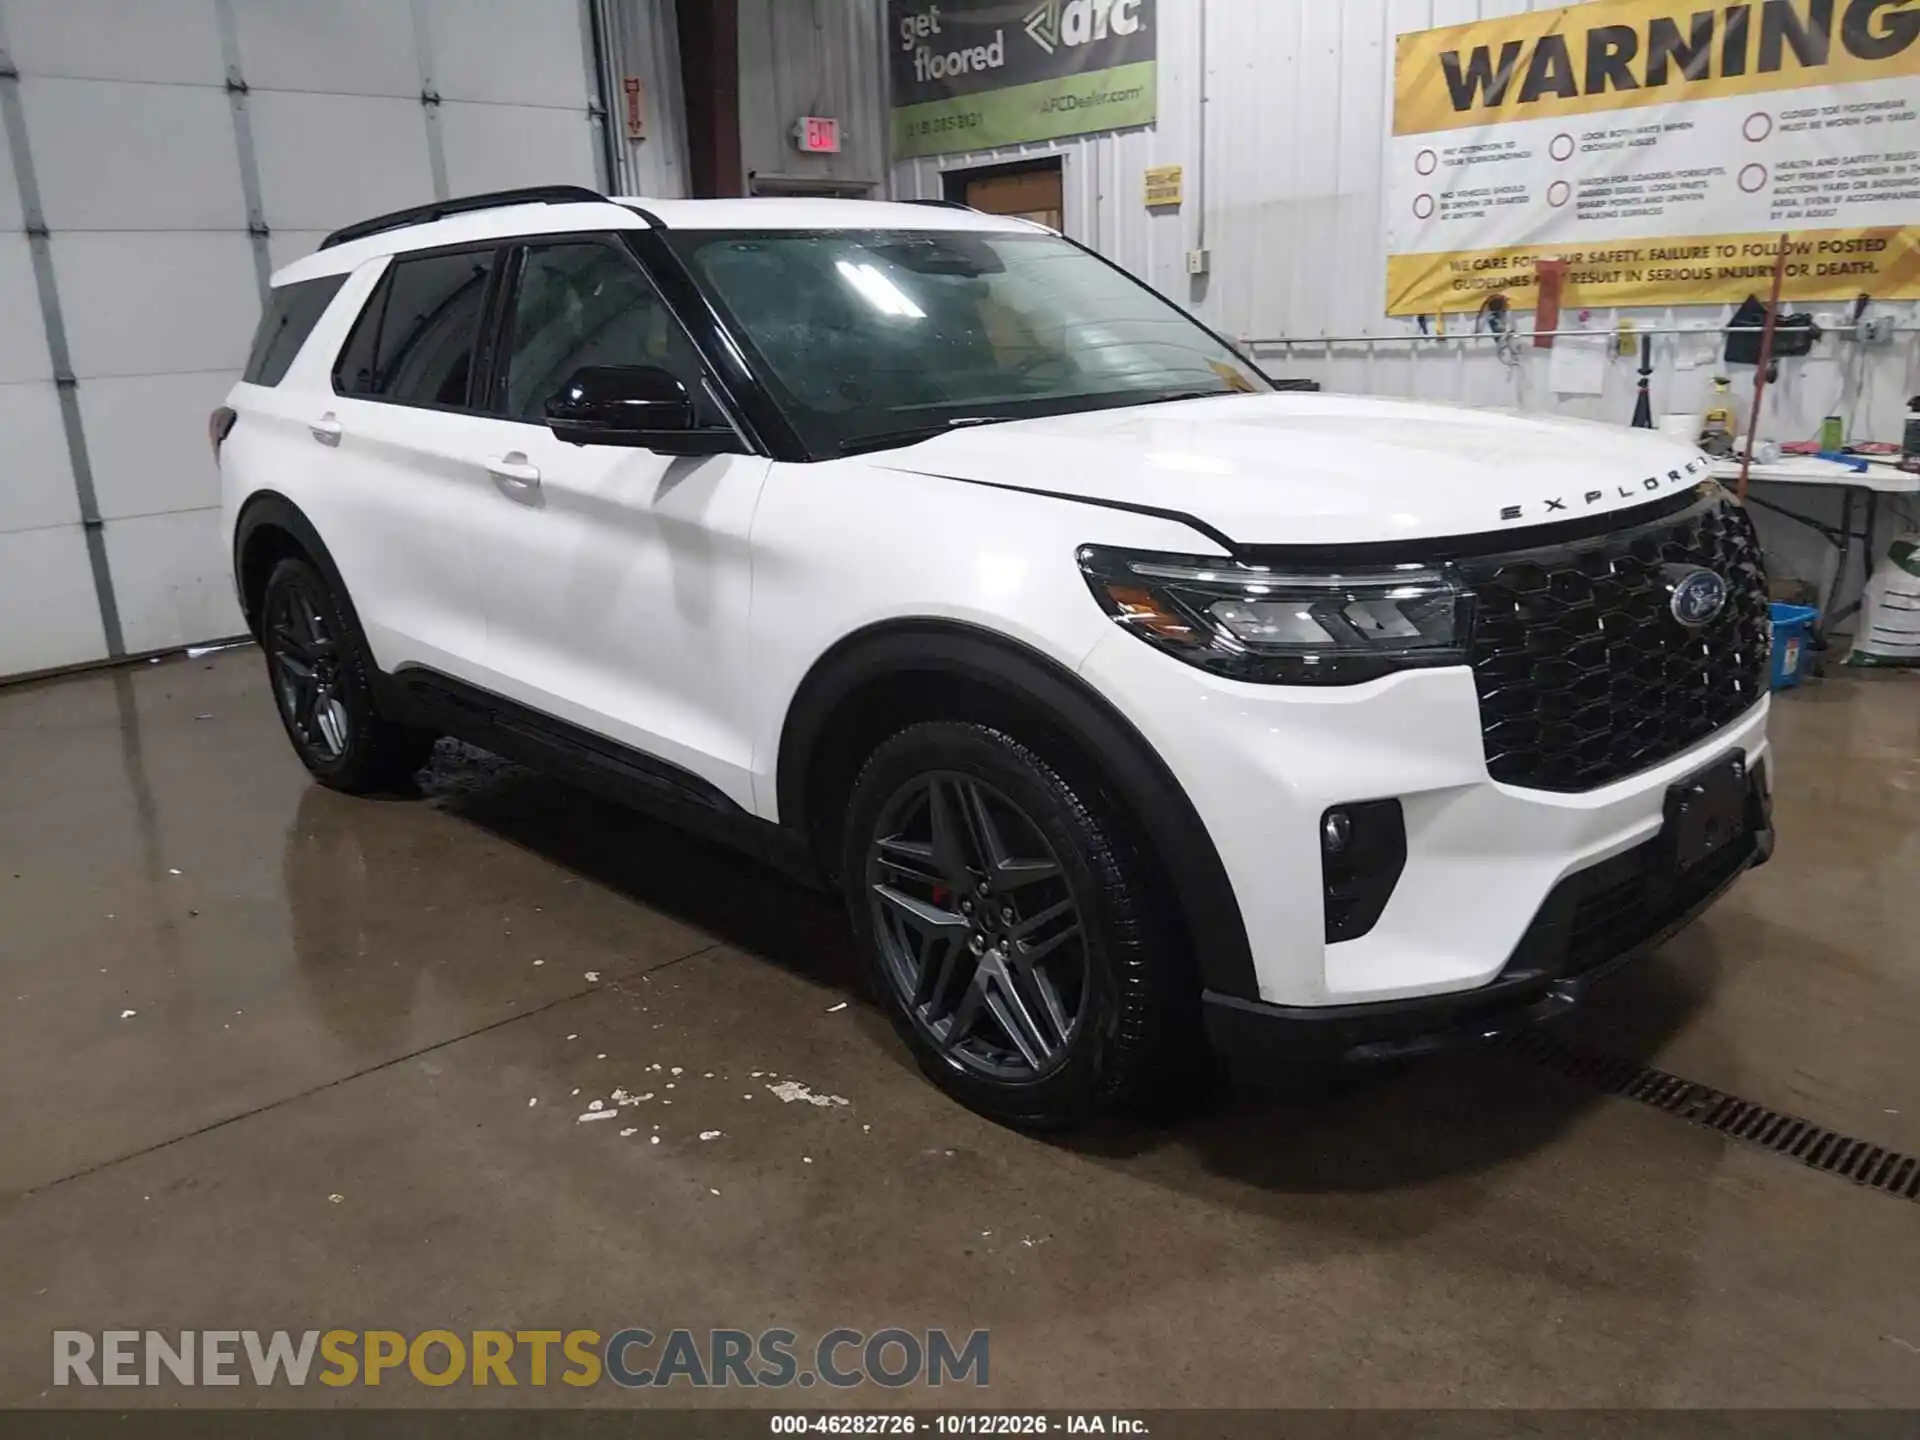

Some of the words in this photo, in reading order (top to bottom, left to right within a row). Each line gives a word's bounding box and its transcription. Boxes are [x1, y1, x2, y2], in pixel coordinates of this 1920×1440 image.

[901, 6, 941, 50] get
[1061, 0, 1141, 46] afc
[914, 30, 1005, 82] floored
[1439, 0, 1920, 111] WARNING
[1809, 121, 1821, 129] BE
[1816, 157, 1839, 167] AND
[1841, 154, 1879, 165] SAFETY
[1450, 261, 1470, 272] WE
[1472, 256, 1507, 270] CARE
[1588, 249, 1645, 264] SAFETY.
[1649, 246, 1711, 261] FAILURE
[1716, 244, 1737, 259] TO
[1742, 241, 1813, 258] FOLLOW
[1818, 238, 1887, 254] POSTED
[1453, 274, 1530, 291] GUIDELINES
[1571, 270, 1621, 284] RESULT
[1625, 269, 1642, 283] IN
[1647, 267, 1713, 282] SERIOUS
[1718, 264, 1777, 279] INJURY
[1785, 263, 1810, 277] OR
[1817, 261, 1879, 276] DEATH.
